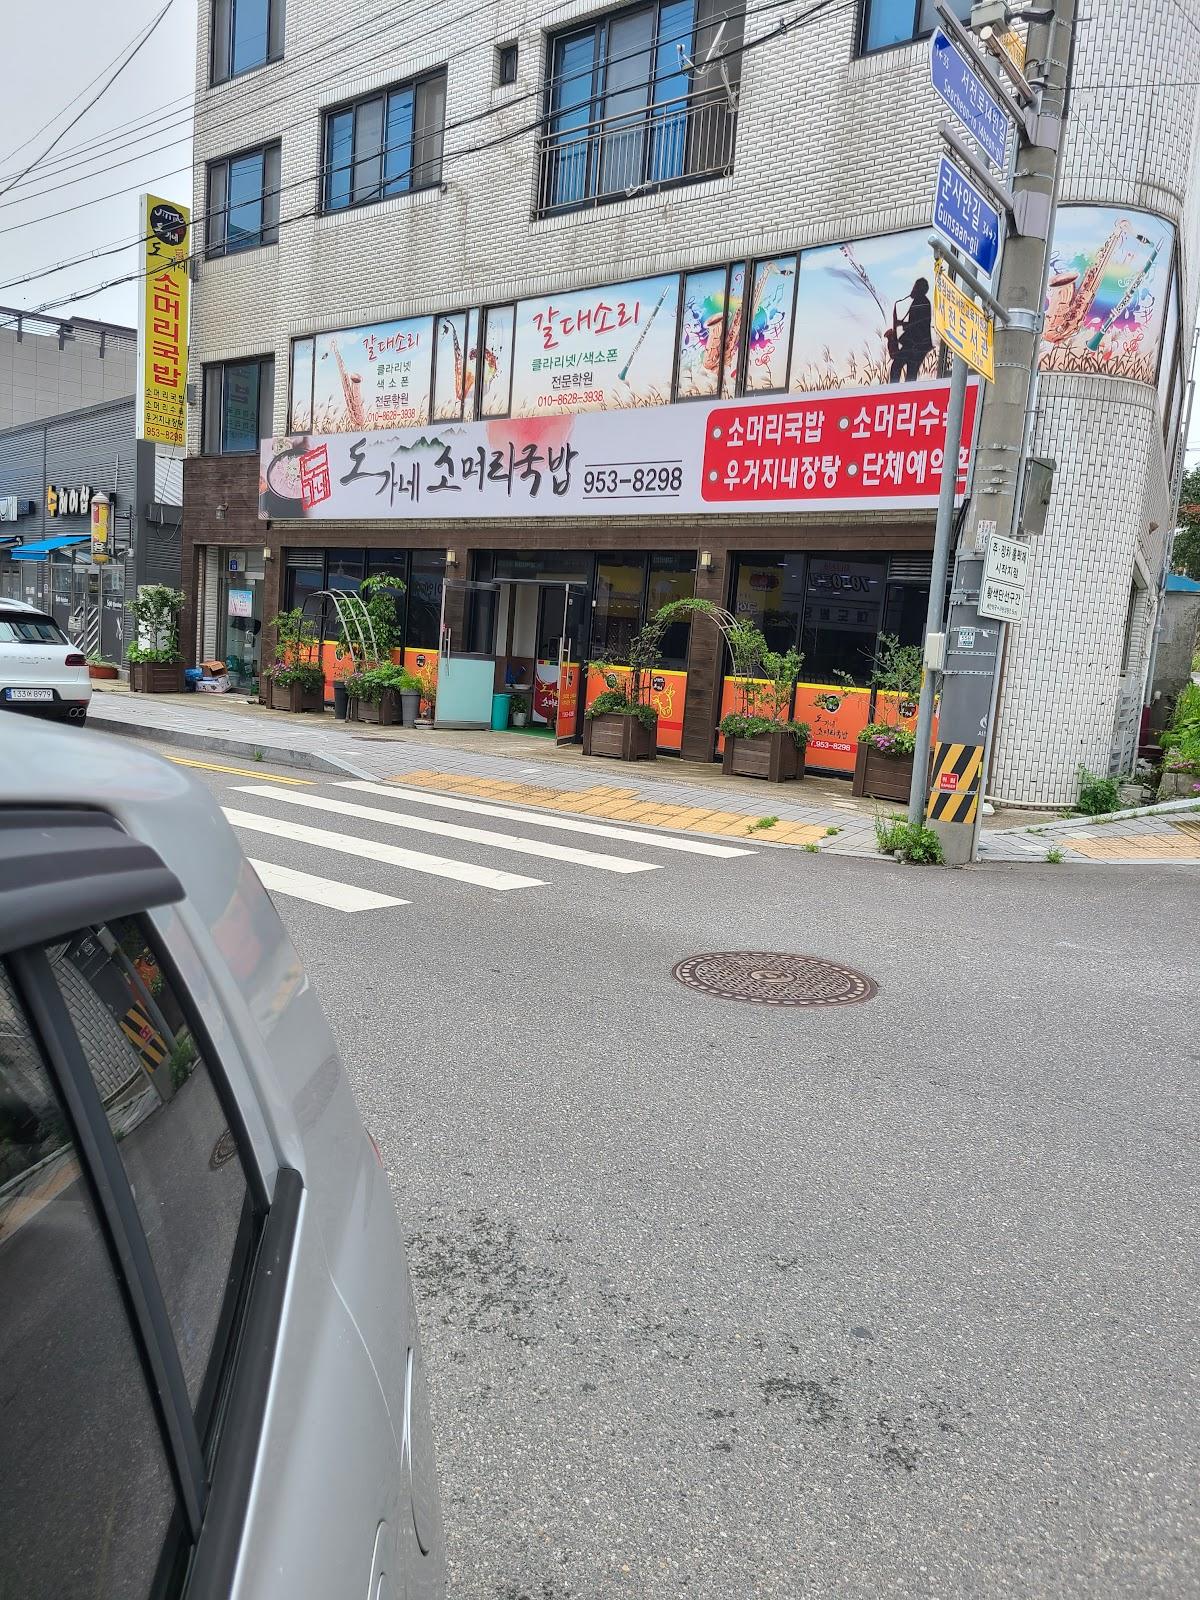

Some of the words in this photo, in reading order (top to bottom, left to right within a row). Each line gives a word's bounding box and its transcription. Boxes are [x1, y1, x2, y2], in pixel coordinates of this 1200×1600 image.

[943, 78, 977, 131] Seocheon-ro
[978, 121, 1003, 162] 14beon-gil
[962, 70, 1006, 145] 서천로14번길
[942, 166, 981, 232] 군사안길
[937, 202, 979, 256] Gunsaan-gil
[153, 273, 181, 388] 소머리국밥
[532, 301, 640, 350] 갈대소리
[939, 300, 988, 359] 서천도서관
[362, 333, 419, 361] 갈대소리
[531, 348, 618, 371] 클라리넷/색소폰
[376, 361, 411, 376] 클라리넷
[551, 371, 593, 390] 전문학원
[375, 392, 409, 408] 전문학원
[537, 390, 604, 407] 010-8628-3938
[367, 408, 416, 422] 010-8628-3938
[726, 410, 826, 448] 소머리국밥
[852, 401, 948, 438] 소머리수
[146, 426, 183, 443] 953-8298
[339, 437, 421, 508] 도가네
[426, 441, 579, 498] 소머리국밥
[583, 466, 683, 494] 953-8298
[723, 454, 842, 491] 우거지내장탕
[986, 586, 1021, 606] 황색단선구간
